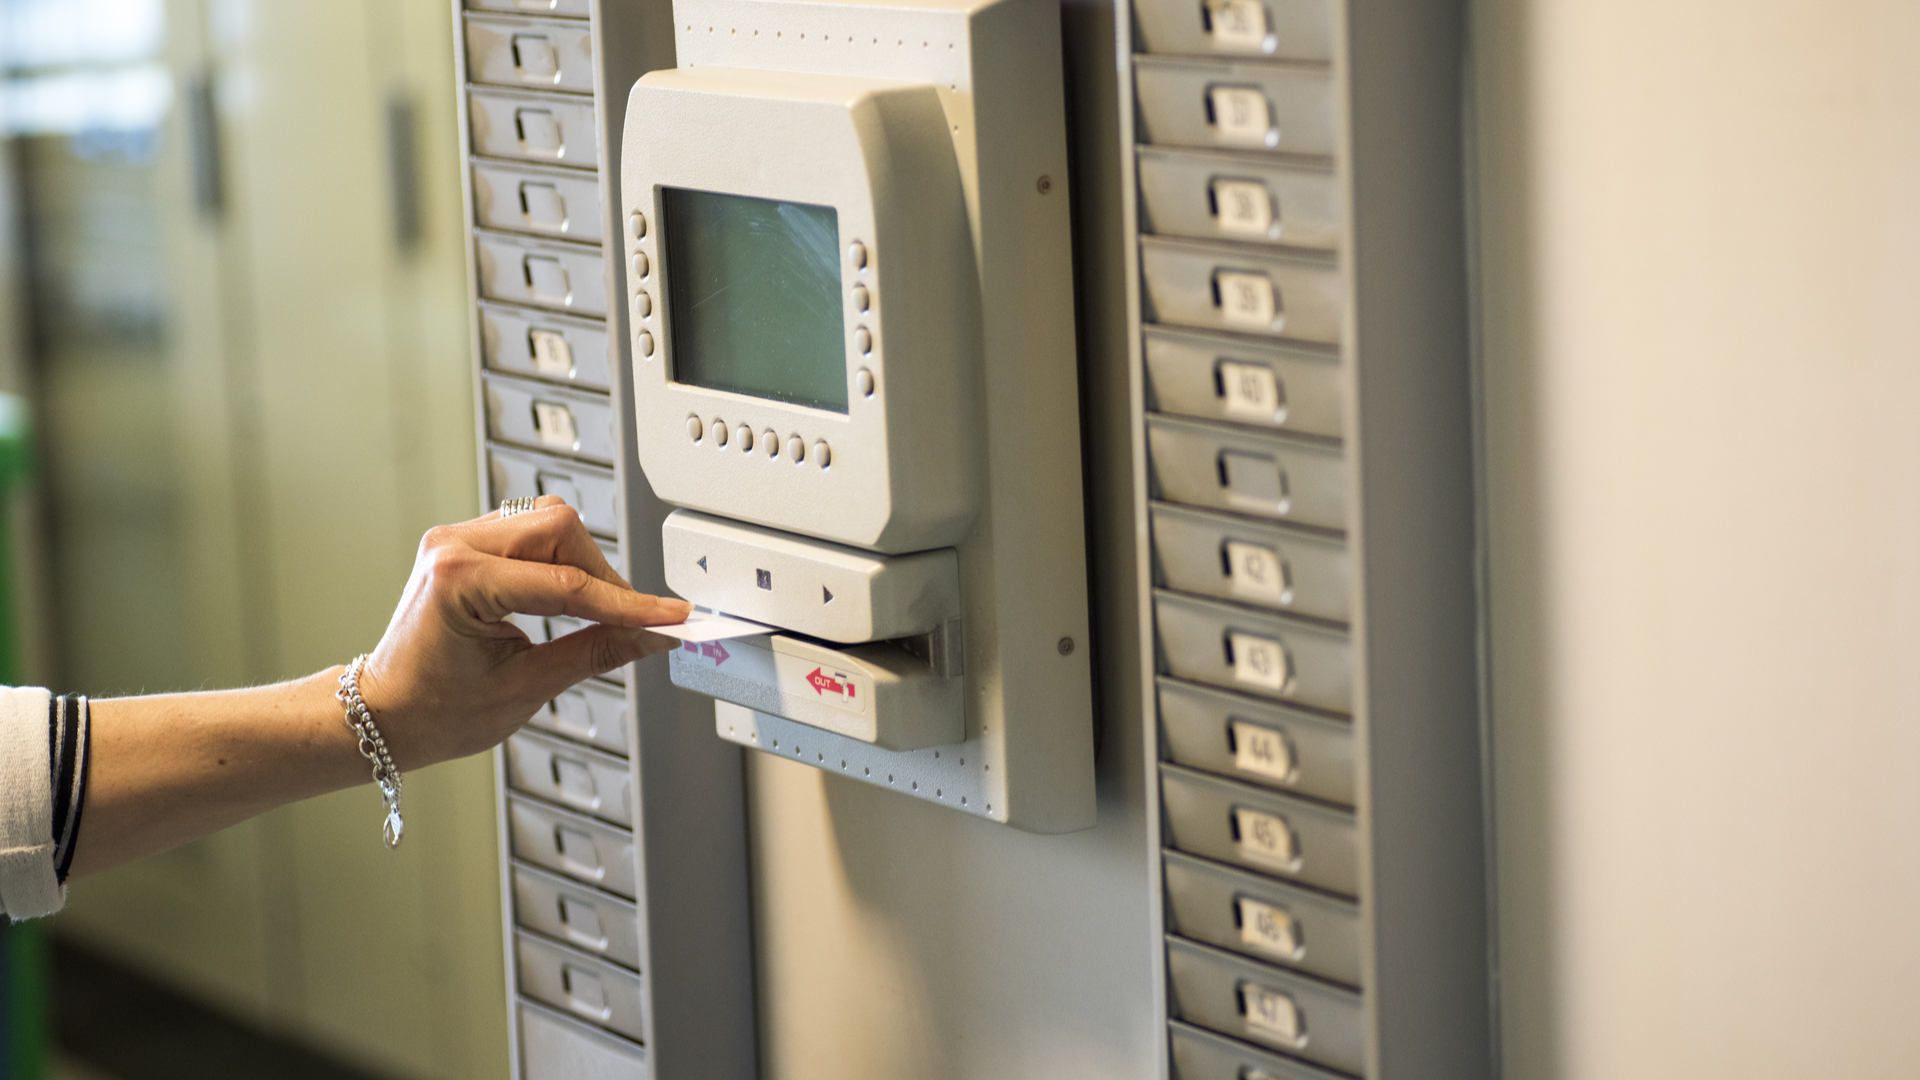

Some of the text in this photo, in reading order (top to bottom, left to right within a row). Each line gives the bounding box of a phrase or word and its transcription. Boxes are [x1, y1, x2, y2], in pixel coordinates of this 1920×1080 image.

[1239, 375, 1262, 406] 40
[1243, 554, 1265, 584] 42
[712, 647, 722, 658] IN
[814, 676, 831, 688] OUT
[1250, 734, 1273, 764] 44
[1256, 995, 1277, 1026] 47
